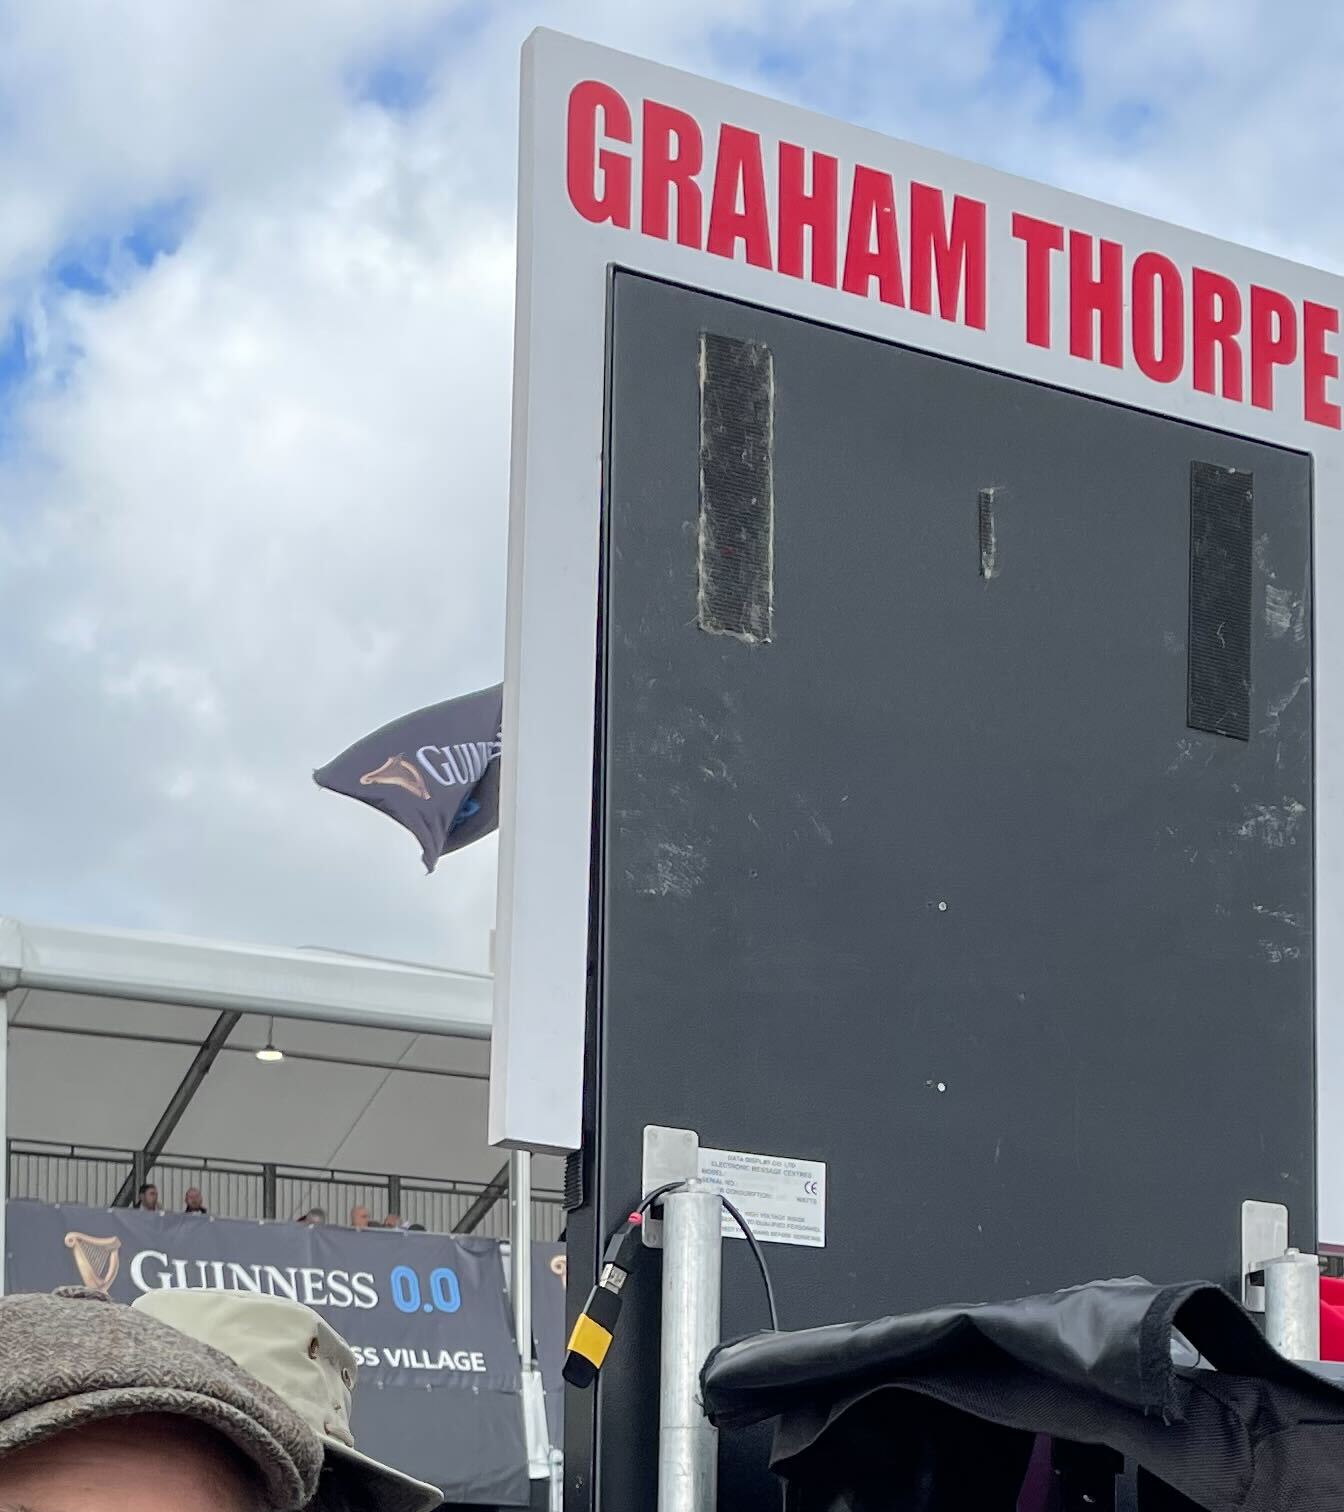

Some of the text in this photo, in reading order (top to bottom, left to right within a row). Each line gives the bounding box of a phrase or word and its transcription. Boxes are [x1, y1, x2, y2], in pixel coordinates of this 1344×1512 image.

[566, 79, 1344, 432] GRAHAM THORPE
[130, 1249, 462, 1313] GUINNESS 0.0
[382, 1347, 487, 1373] VILLAGE
